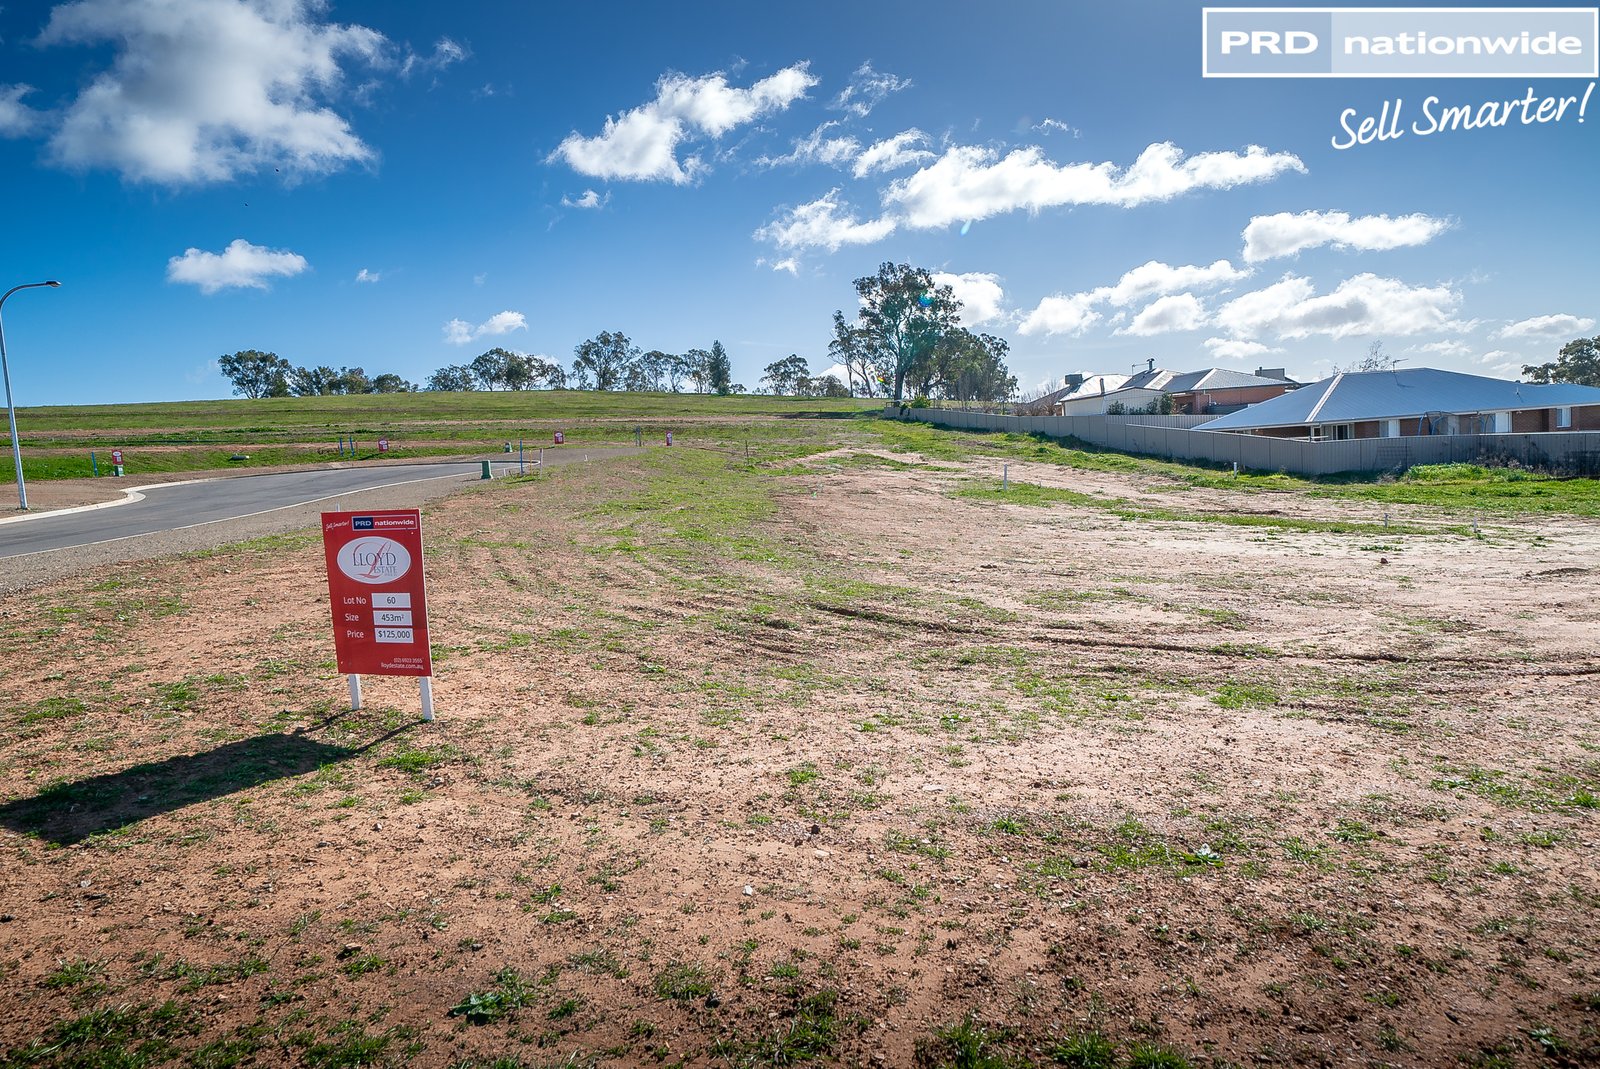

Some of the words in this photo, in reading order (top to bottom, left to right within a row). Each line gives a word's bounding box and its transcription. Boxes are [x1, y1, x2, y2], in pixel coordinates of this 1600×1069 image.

[352, 552, 397, 567] LLOYD
[373, 565, 398, 574] ESTATE
[343, 596, 356, 605] Lot
[356, 596, 367, 605] No
[386, 596, 396, 605] 60
[344, 612, 359, 622] Size
[346, 629, 365, 638] Price
[378, 630, 411, 639] $125,000
